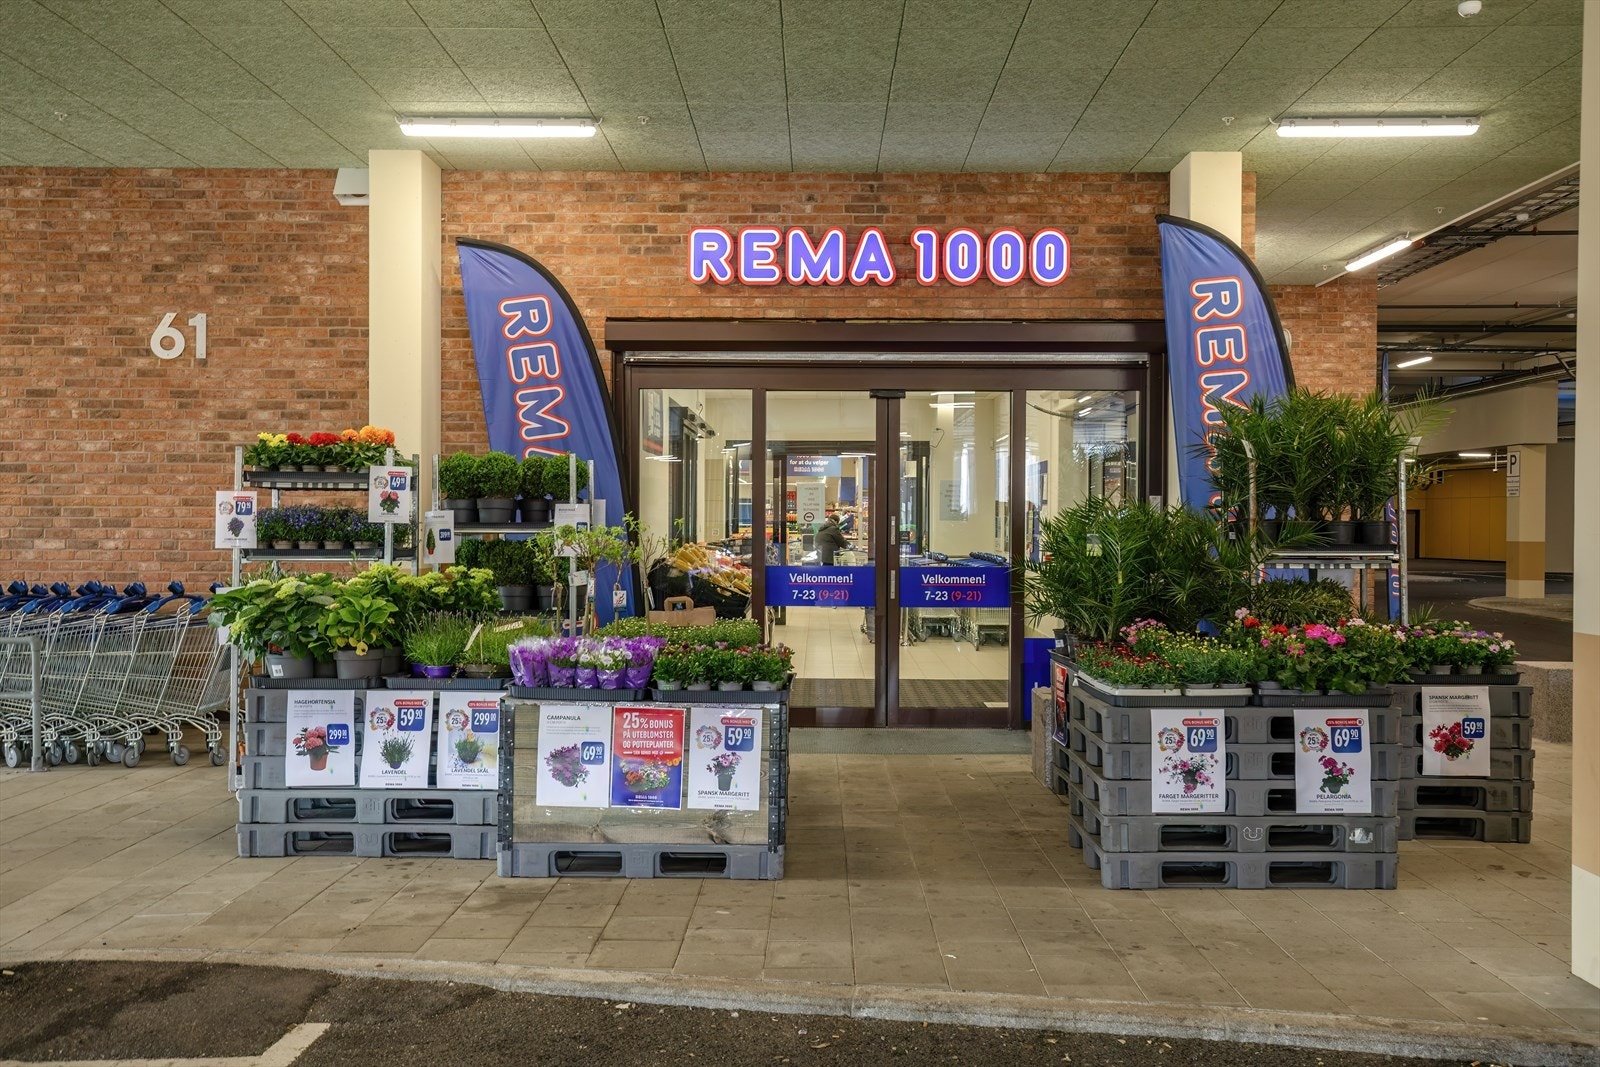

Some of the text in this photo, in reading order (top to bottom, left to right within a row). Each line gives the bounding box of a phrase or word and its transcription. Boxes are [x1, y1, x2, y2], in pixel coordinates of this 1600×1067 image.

[688, 226, 1070, 286] REMA 1000
[150, 312, 207, 360] 61
[1510, 454, 1517, 475] P
[391, 477, 400, 488] 49
[236, 501, 246, 513] 79
[789, 572, 853, 583] Velkommen!
[922, 573, 986, 584] Velkommen!
[792, 589, 849, 601] 7-23 (9-21)
[924, 590, 982, 602] 7-23 (9-21)
[400, 708, 423, 726] 59 90
[474, 712, 490, 726] 299
[623, 712, 674, 729] 25% BONUS
[329, 729, 342, 740] 299
[623, 729, 674, 739] PÅ UTEBLOMSTER
[1464, 721, 1476, 735] 59
[728, 727, 752, 746] 59 90
[1190, 728, 1215, 747] 69 90
[1334, 728, 1359, 748] 69 90
[623, 740, 674, 749] OG POTTEPLANTER
[583, 746, 596, 761] 69
[719, 790, 750, 798] MARGERITT
